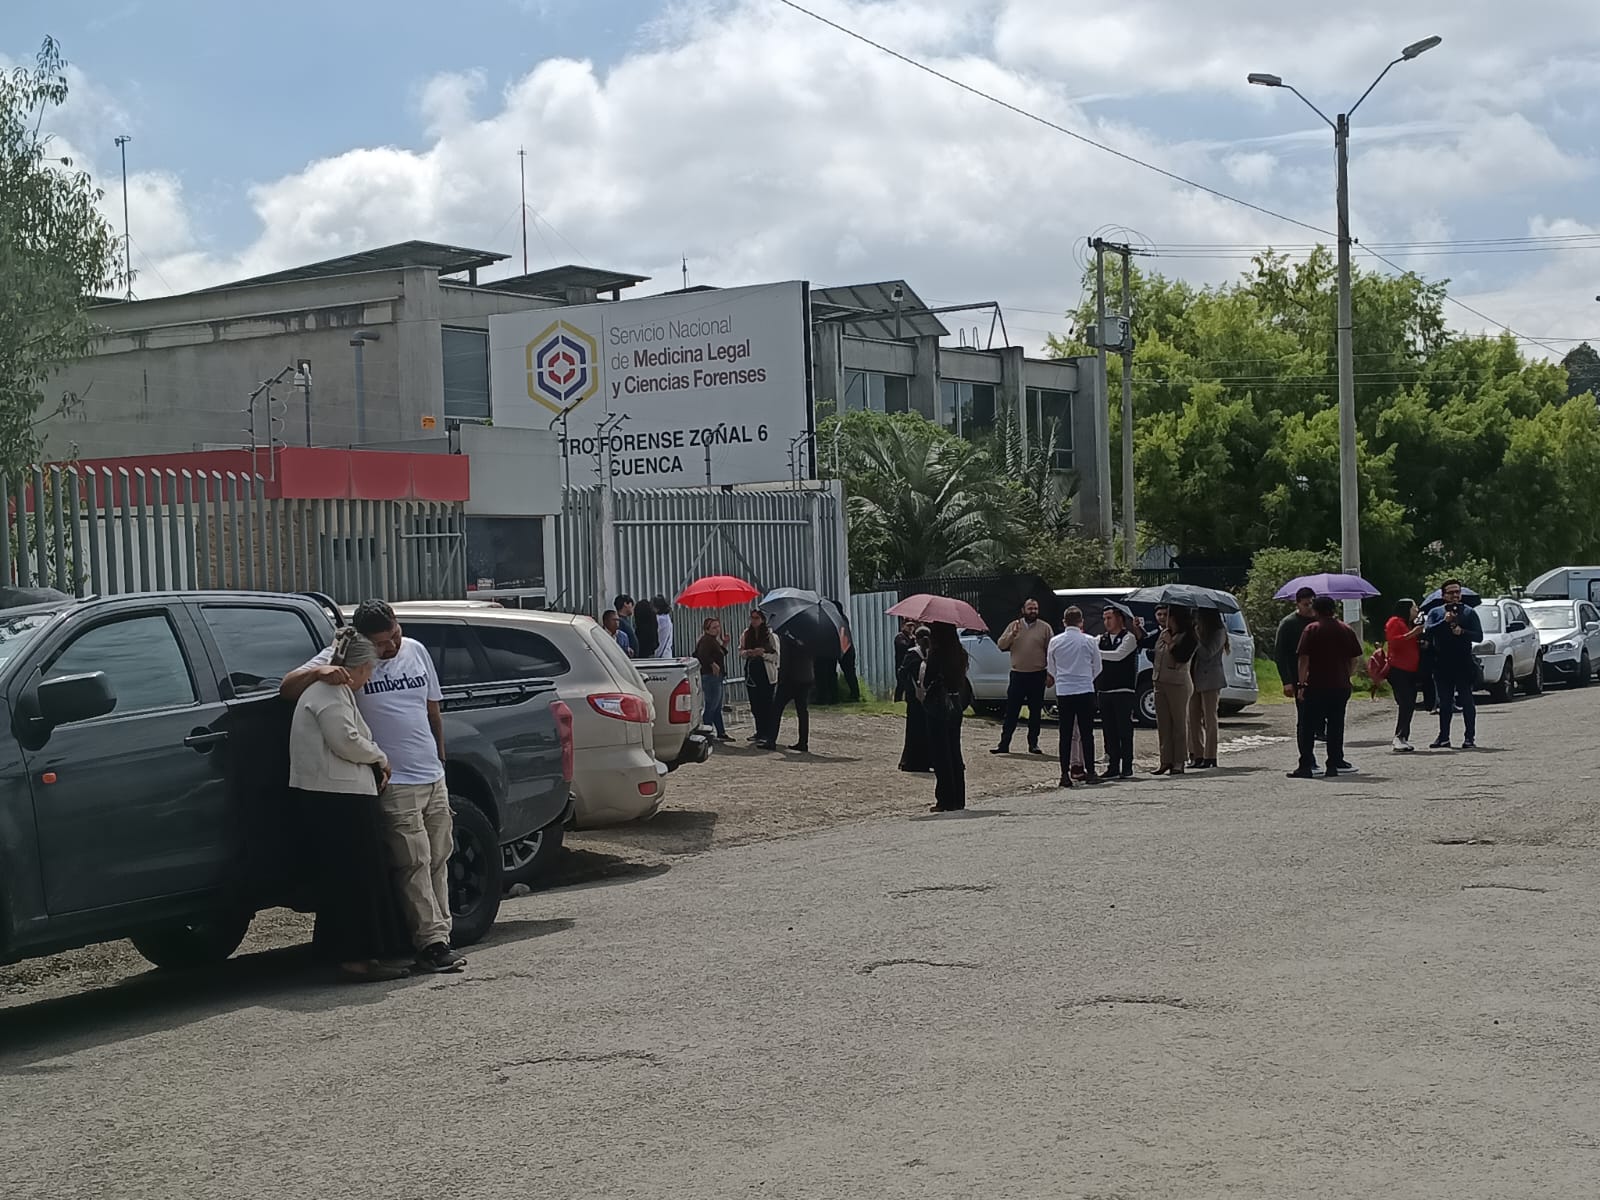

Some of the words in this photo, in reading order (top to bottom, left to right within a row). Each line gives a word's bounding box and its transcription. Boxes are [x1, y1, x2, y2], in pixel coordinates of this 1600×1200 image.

[609, 323, 665, 346] Servicio
[668, 314, 732, 340] Nacional
[611, 352, 630, 371] de
[633, 345, 703, 368] Medicina
[707, 338, 751, 363] Legal
[612, 381, 621, 399] y
[624, 373, 690, 394] Ciencias
[693, 367, 767, 388] Forenses
[600, 430, 684, 453] FORENSE
[757, 424, 768, 442] 6
[610, 455, 684, 476] CUENCA
